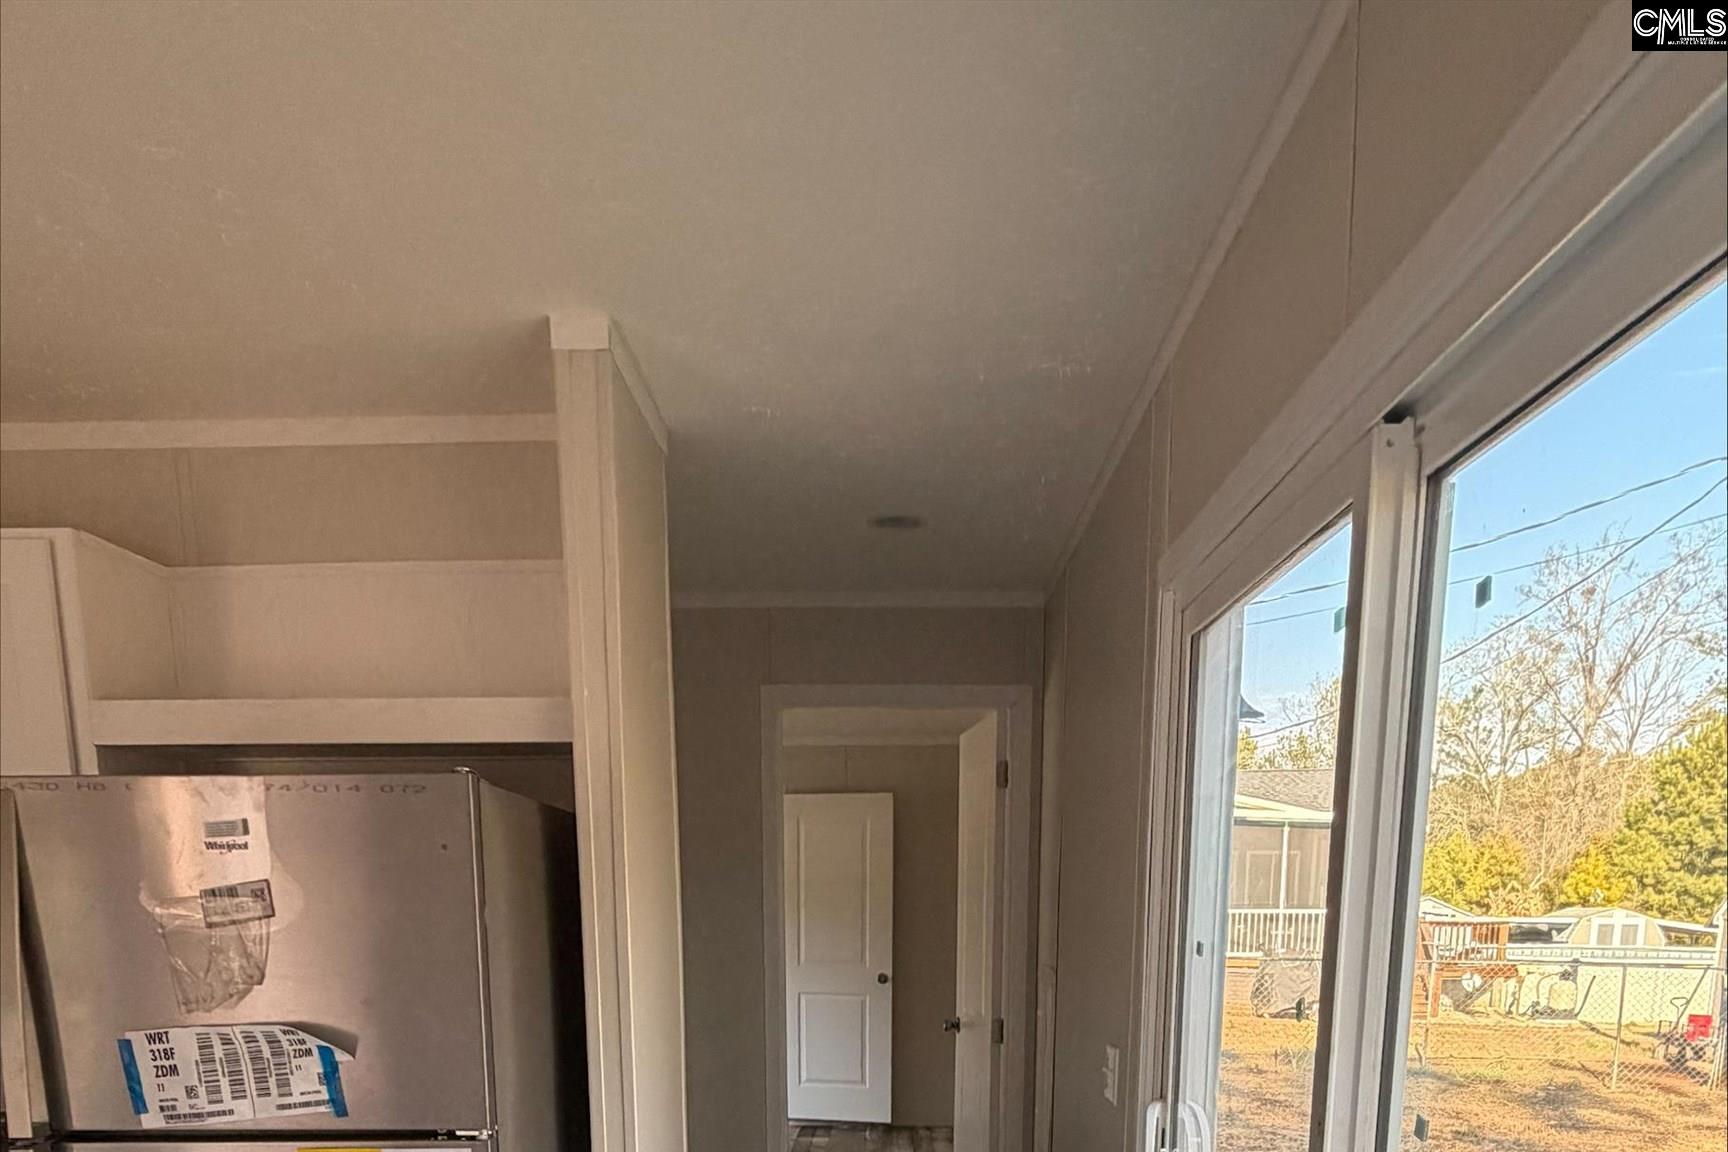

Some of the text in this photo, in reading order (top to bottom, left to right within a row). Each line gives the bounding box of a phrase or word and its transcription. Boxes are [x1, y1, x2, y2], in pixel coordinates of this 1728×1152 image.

[204, 840, 249, 855] Whirlpool
[144, 1031, 170, 1046] WRT
[148, 1047, 176, 1062] 318F
[291, 1047, 314, 1059] ZDM
[153, 1064, 180, 1078] ZDM
